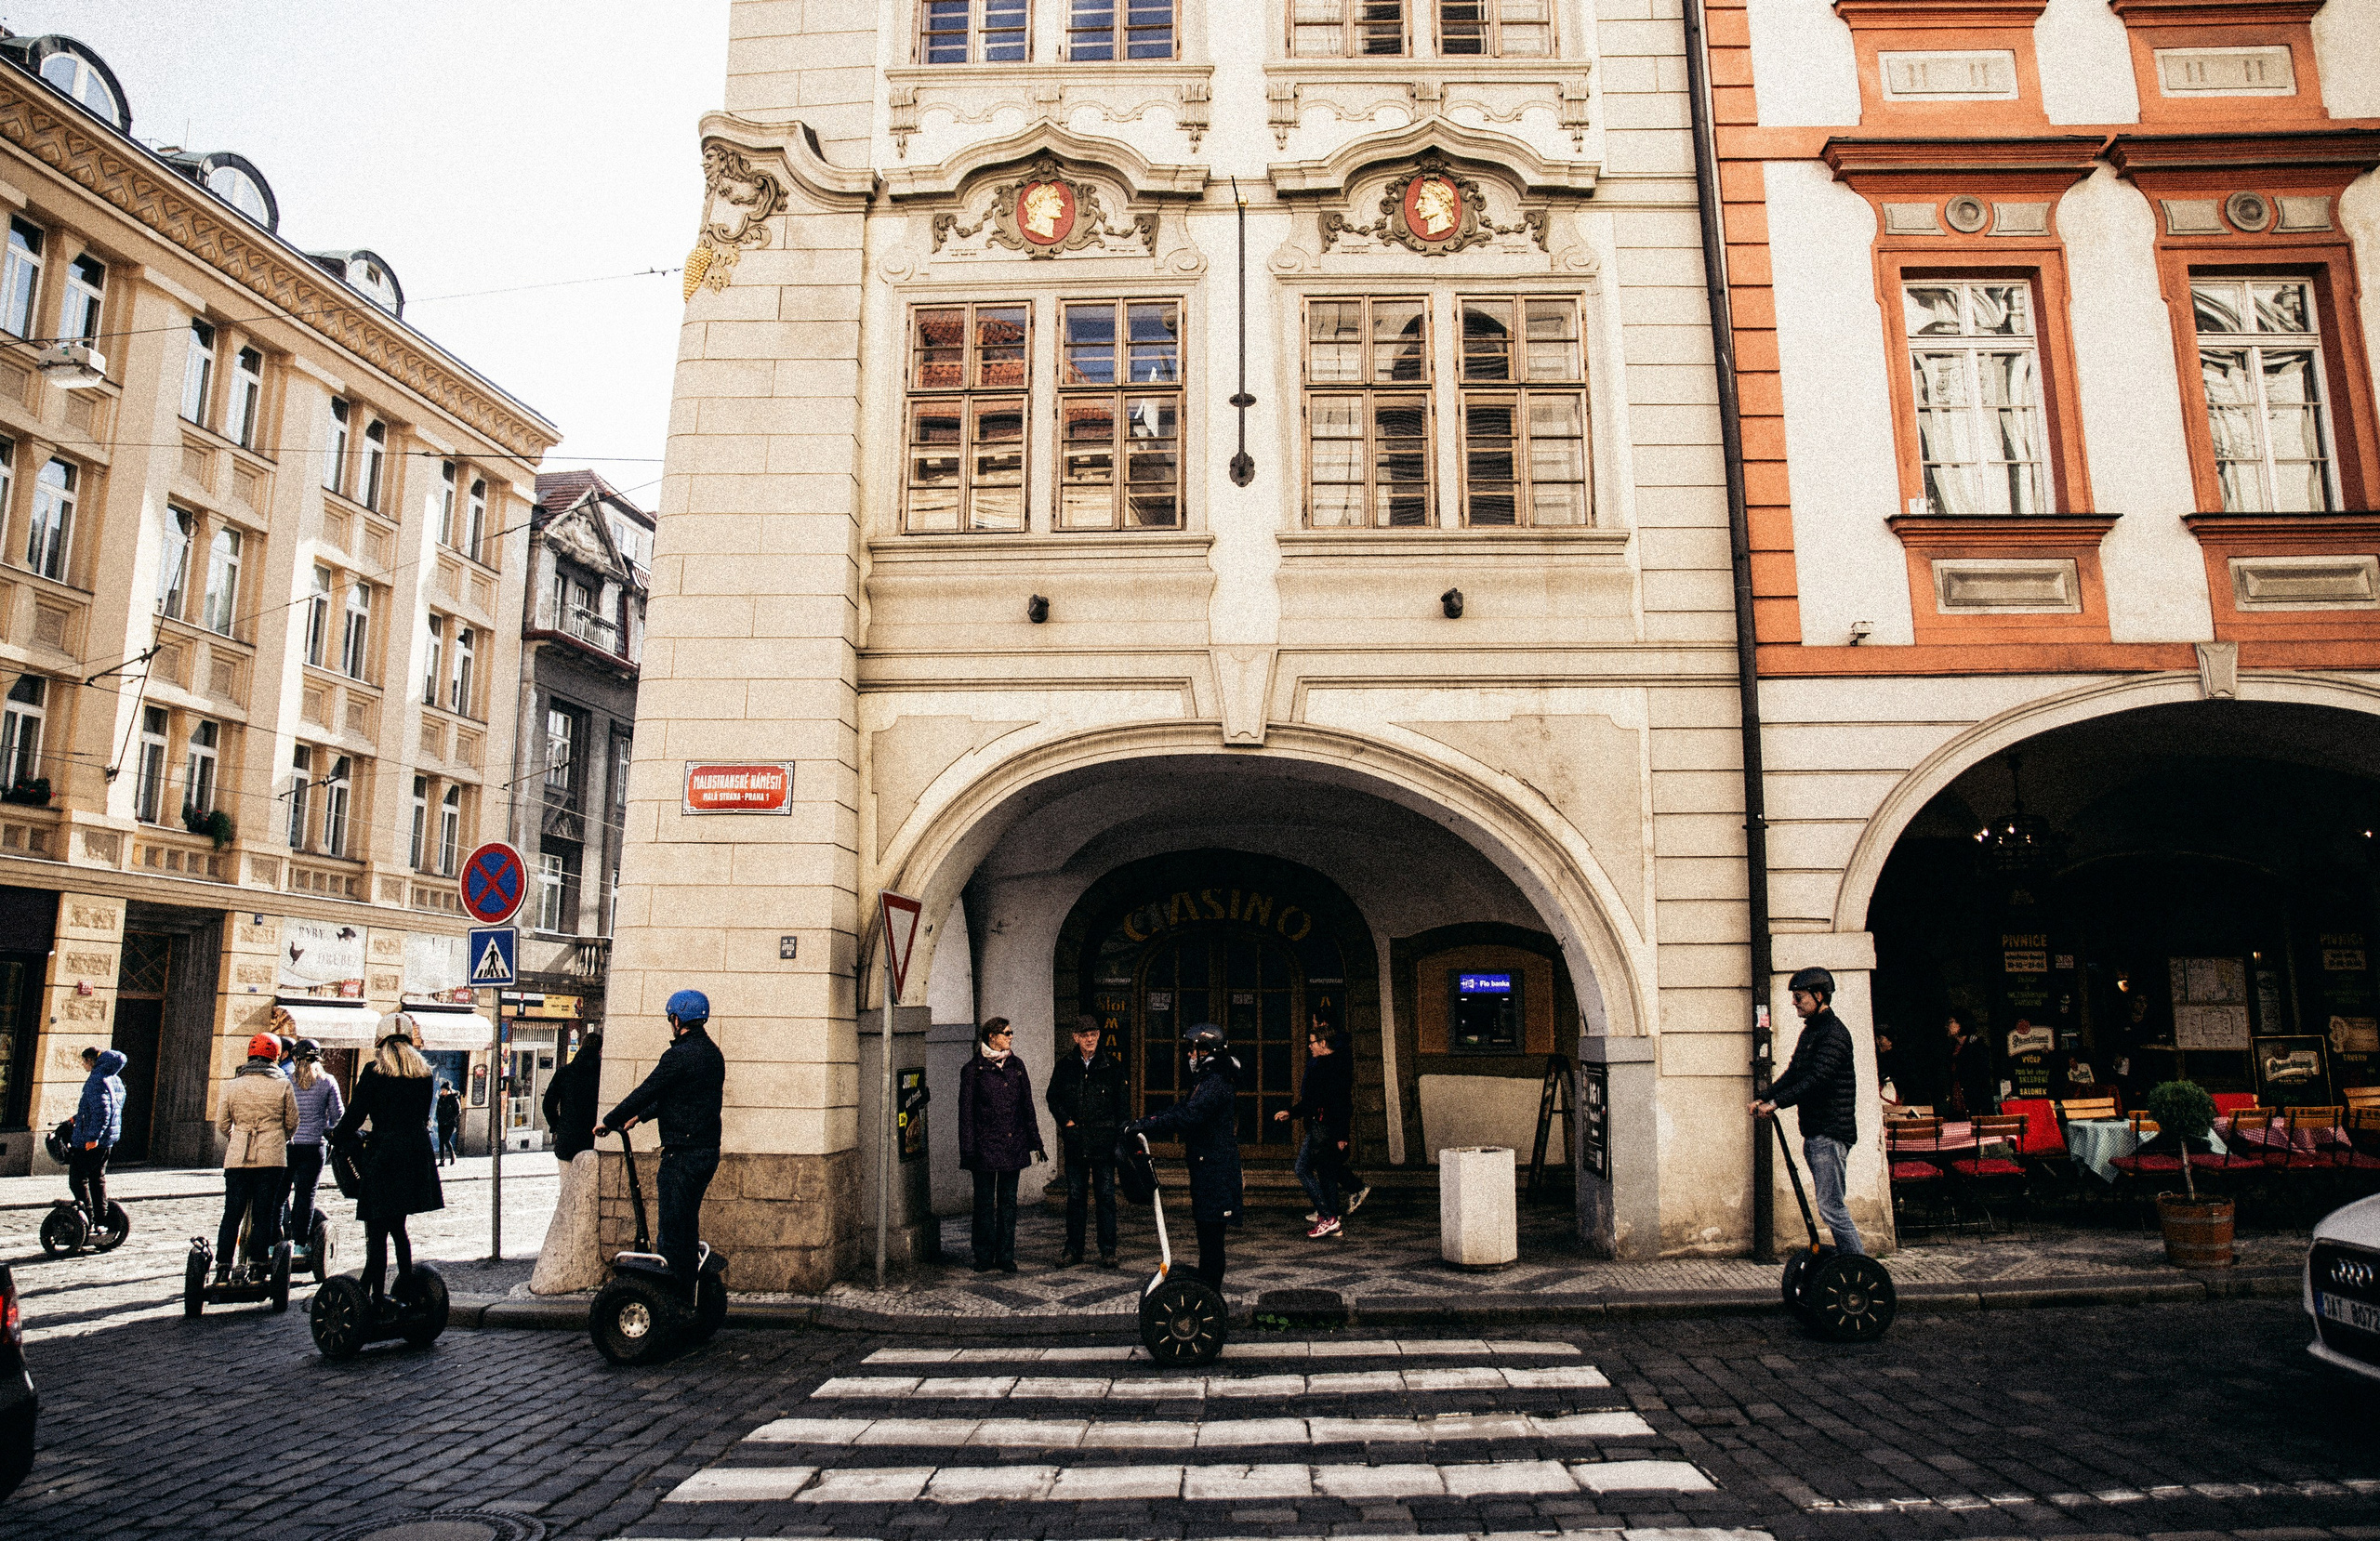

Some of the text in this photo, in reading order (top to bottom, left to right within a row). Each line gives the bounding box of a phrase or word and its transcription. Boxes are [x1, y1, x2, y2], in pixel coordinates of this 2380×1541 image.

[694, 772, 783, 790] MALOSTRANSKÉ NÁMĚSTÍ
[703, 791, 718, 801] MALÁ
[719, 792, 741, 801] STRANA
[745, 792, 764, 801] PRAHA
[1123, 889, 1312, 942] CASINO
[298, 926, 324, 940] RYBY
[2002, 933, 2048, 948] PIVNICE
